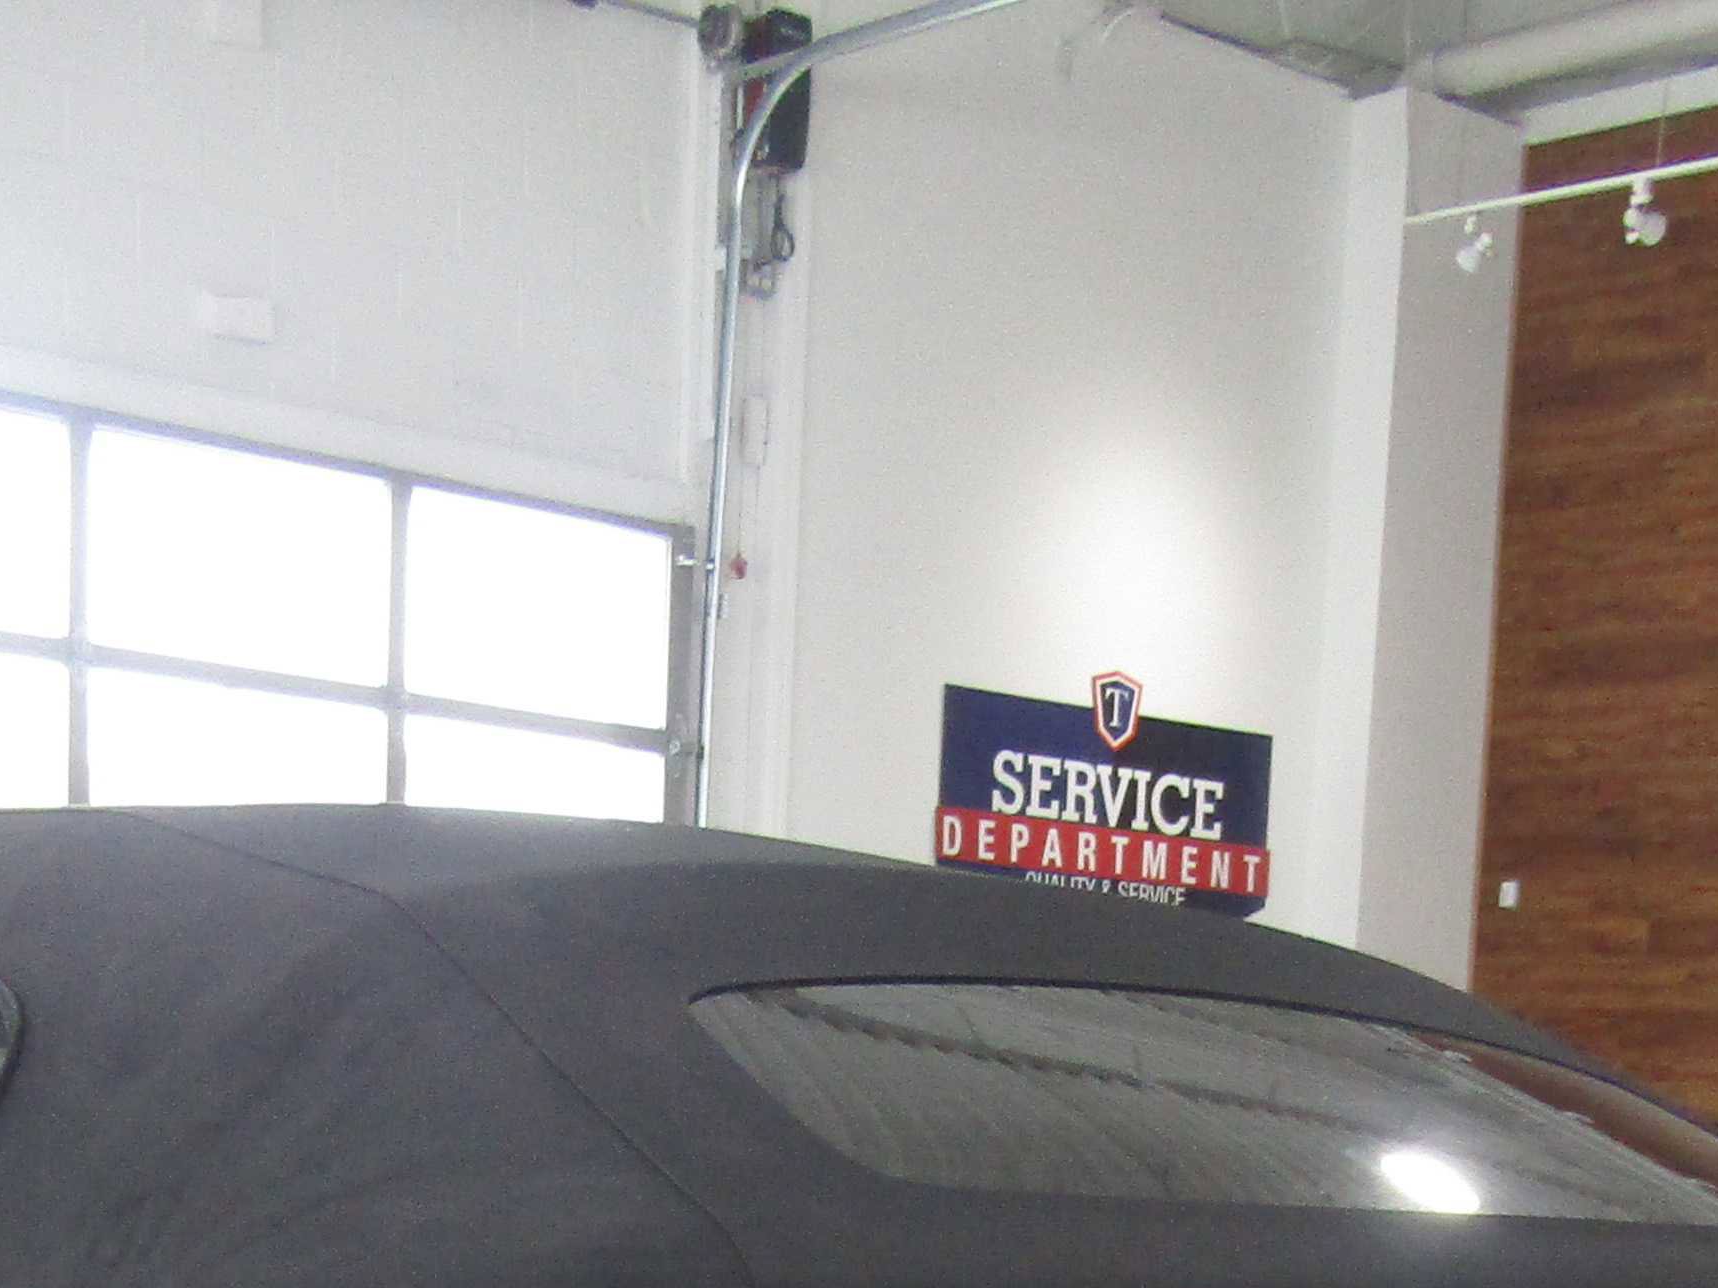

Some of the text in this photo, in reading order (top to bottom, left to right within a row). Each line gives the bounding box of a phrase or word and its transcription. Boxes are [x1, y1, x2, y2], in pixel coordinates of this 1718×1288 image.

[1104, 686, 1130, 729] T
[991, 749, 1225, 841] SERVICE
[941, 813, 1263, 893] DEPARTMENT
